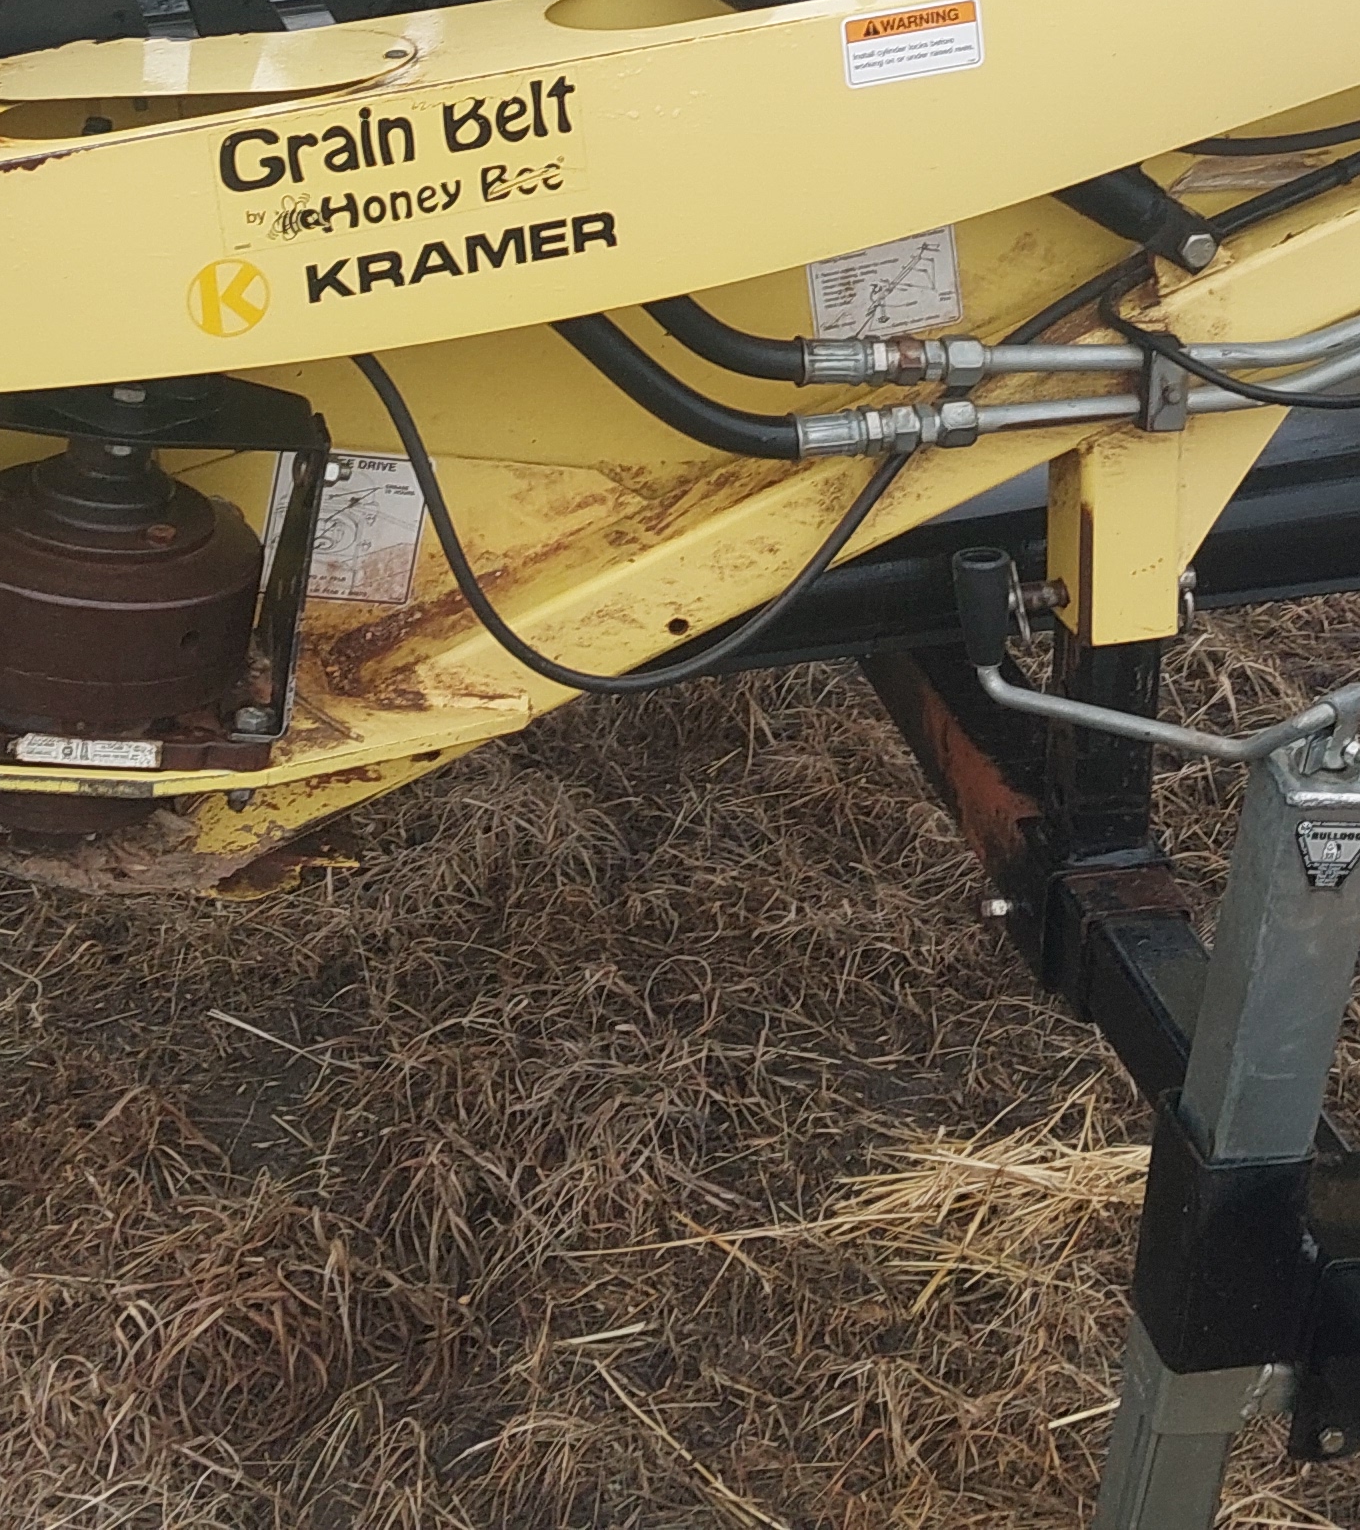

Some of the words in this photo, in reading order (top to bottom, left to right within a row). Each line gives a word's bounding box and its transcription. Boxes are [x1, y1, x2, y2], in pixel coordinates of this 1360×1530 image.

[880, 7, 960, 33] WARNING
[219, 106, 415, 192] Grain
[443, 76, 577, 153] Belt
[245, 209, 267, 225] by
[321, 177, 462, 232] Honey
[482, 162, 562, 202] Bee
[306, 211, 619, 304] KRAMER
[357, 459, 398, 472] DRIVE
